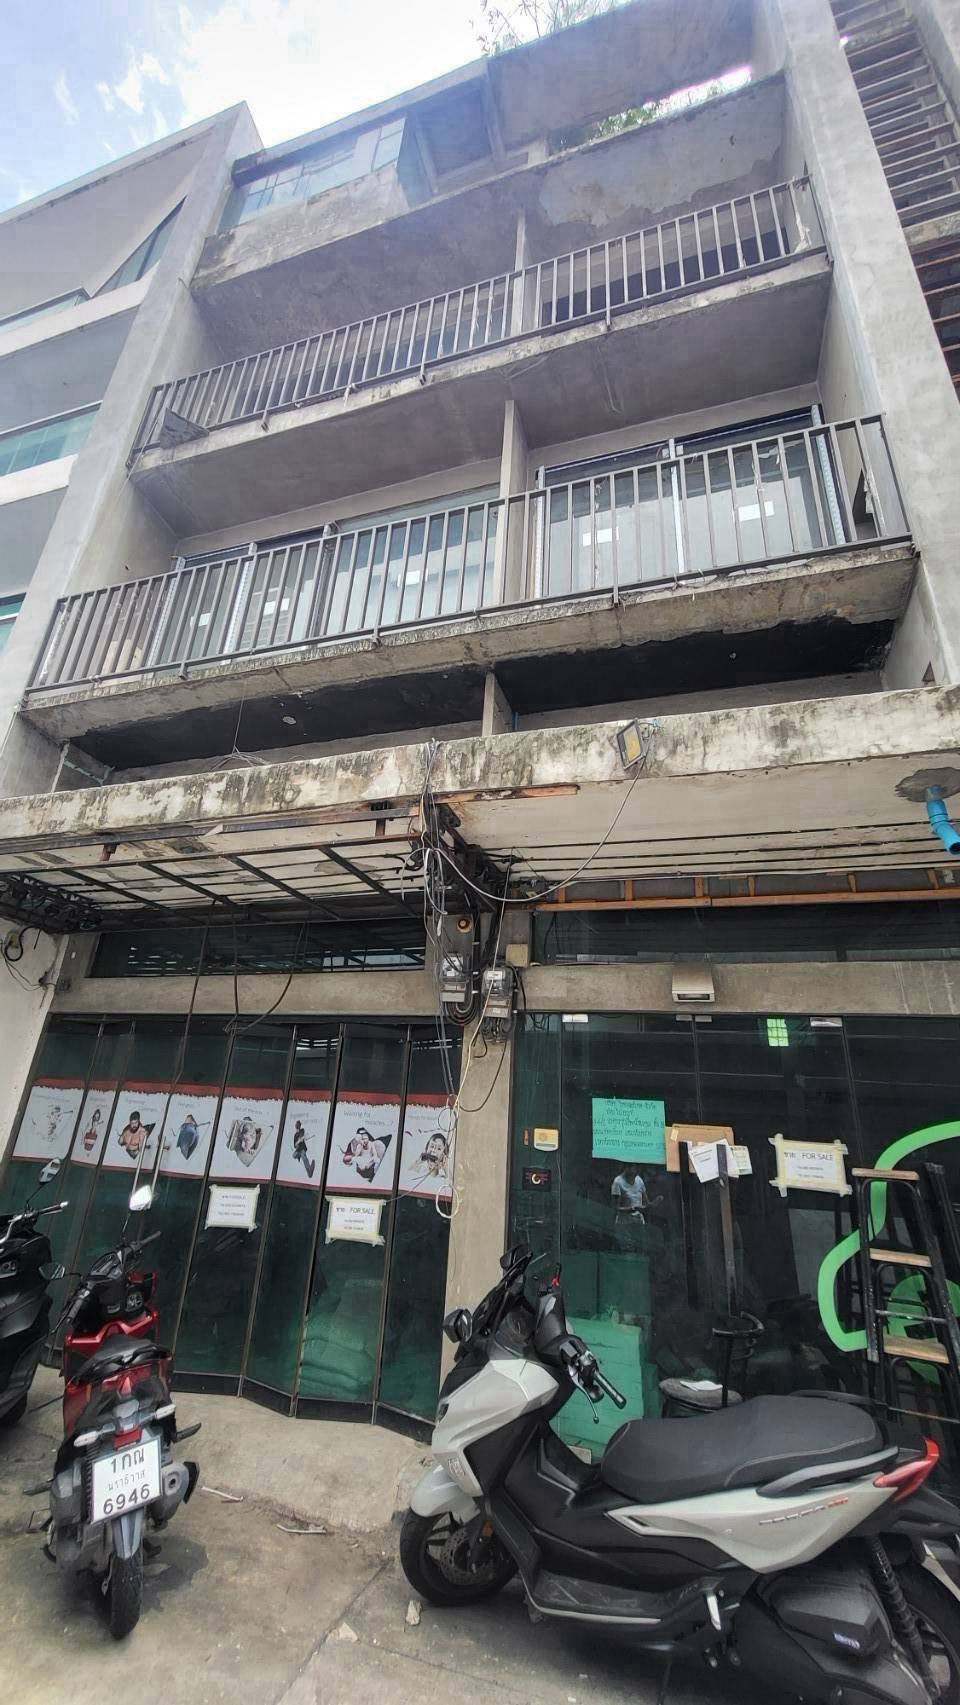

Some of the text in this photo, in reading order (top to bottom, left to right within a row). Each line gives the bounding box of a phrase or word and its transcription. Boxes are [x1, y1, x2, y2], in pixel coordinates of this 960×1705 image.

[802, 1152, 815, 1160] FOR
[817, 1153, 833, 1161] SALE
[103, 1484, 150, 1515] 6946
